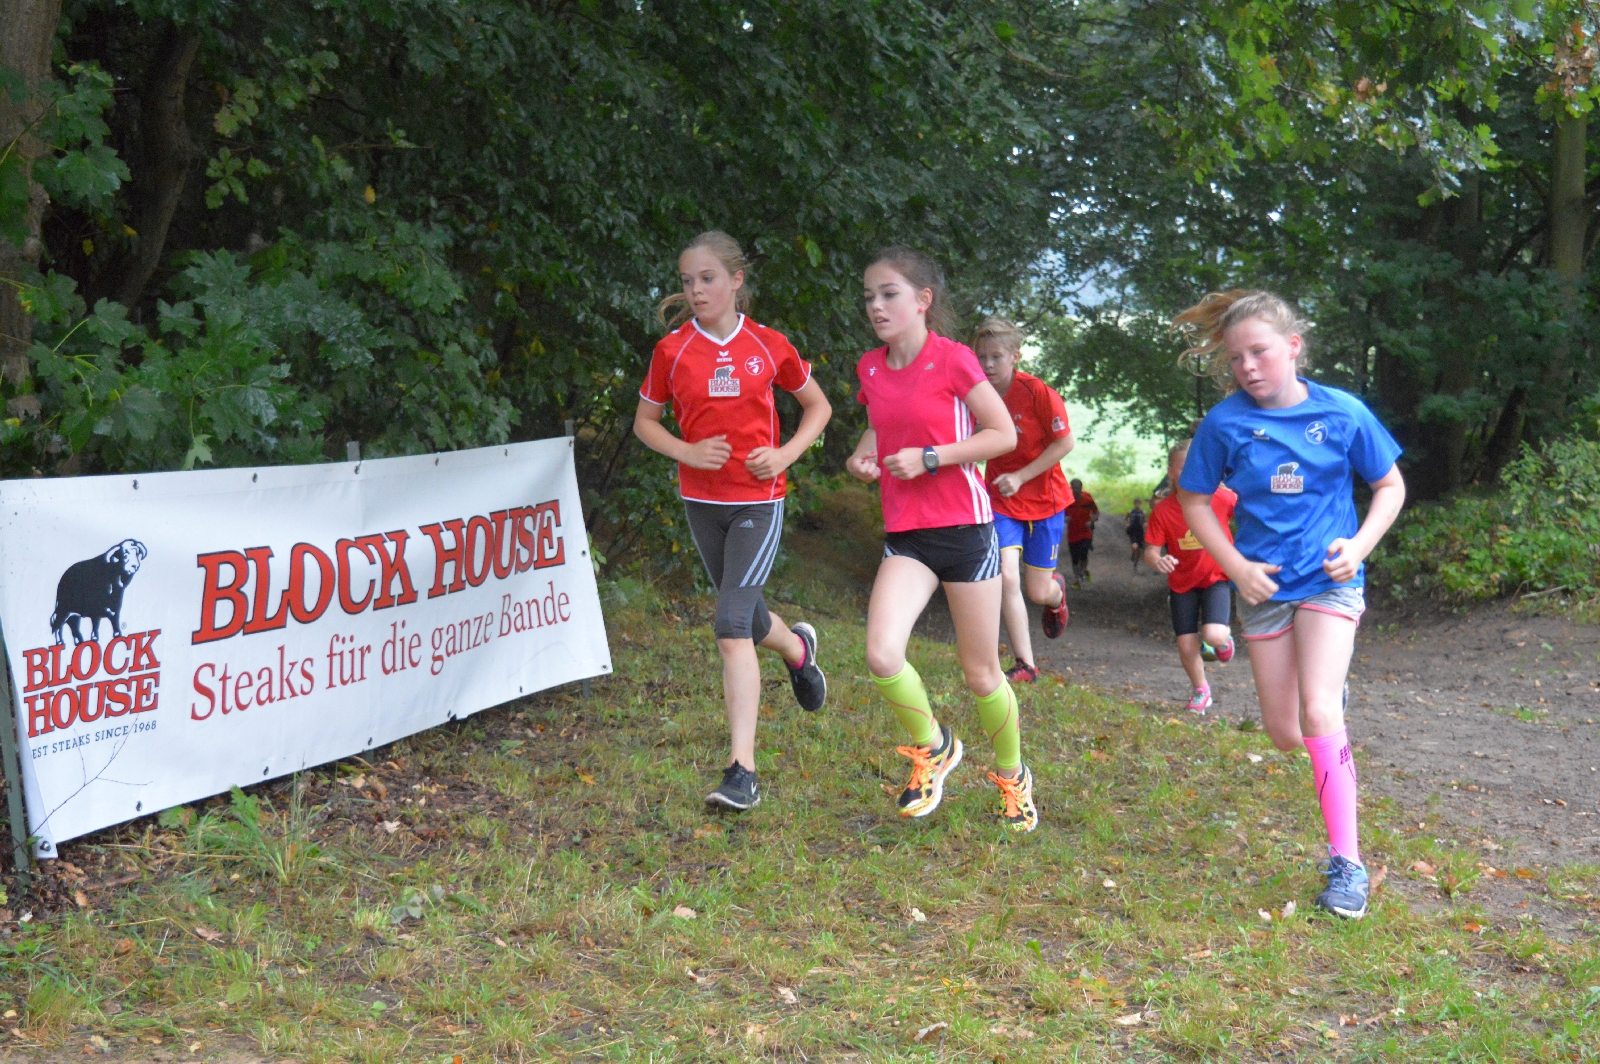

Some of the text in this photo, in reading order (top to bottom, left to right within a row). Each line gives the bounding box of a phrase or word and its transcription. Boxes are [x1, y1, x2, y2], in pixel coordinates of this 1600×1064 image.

[191, 499, 566, 645] BLOCK HOUSE
[22, 629, 161, 693] BLOCK
[191, 580, 571, 721] Steaks für die ganze Bande
[24, 671, 160, 738] HOUSE
[32, 720, 157, 760] EST STEAKS SINCE 1968
